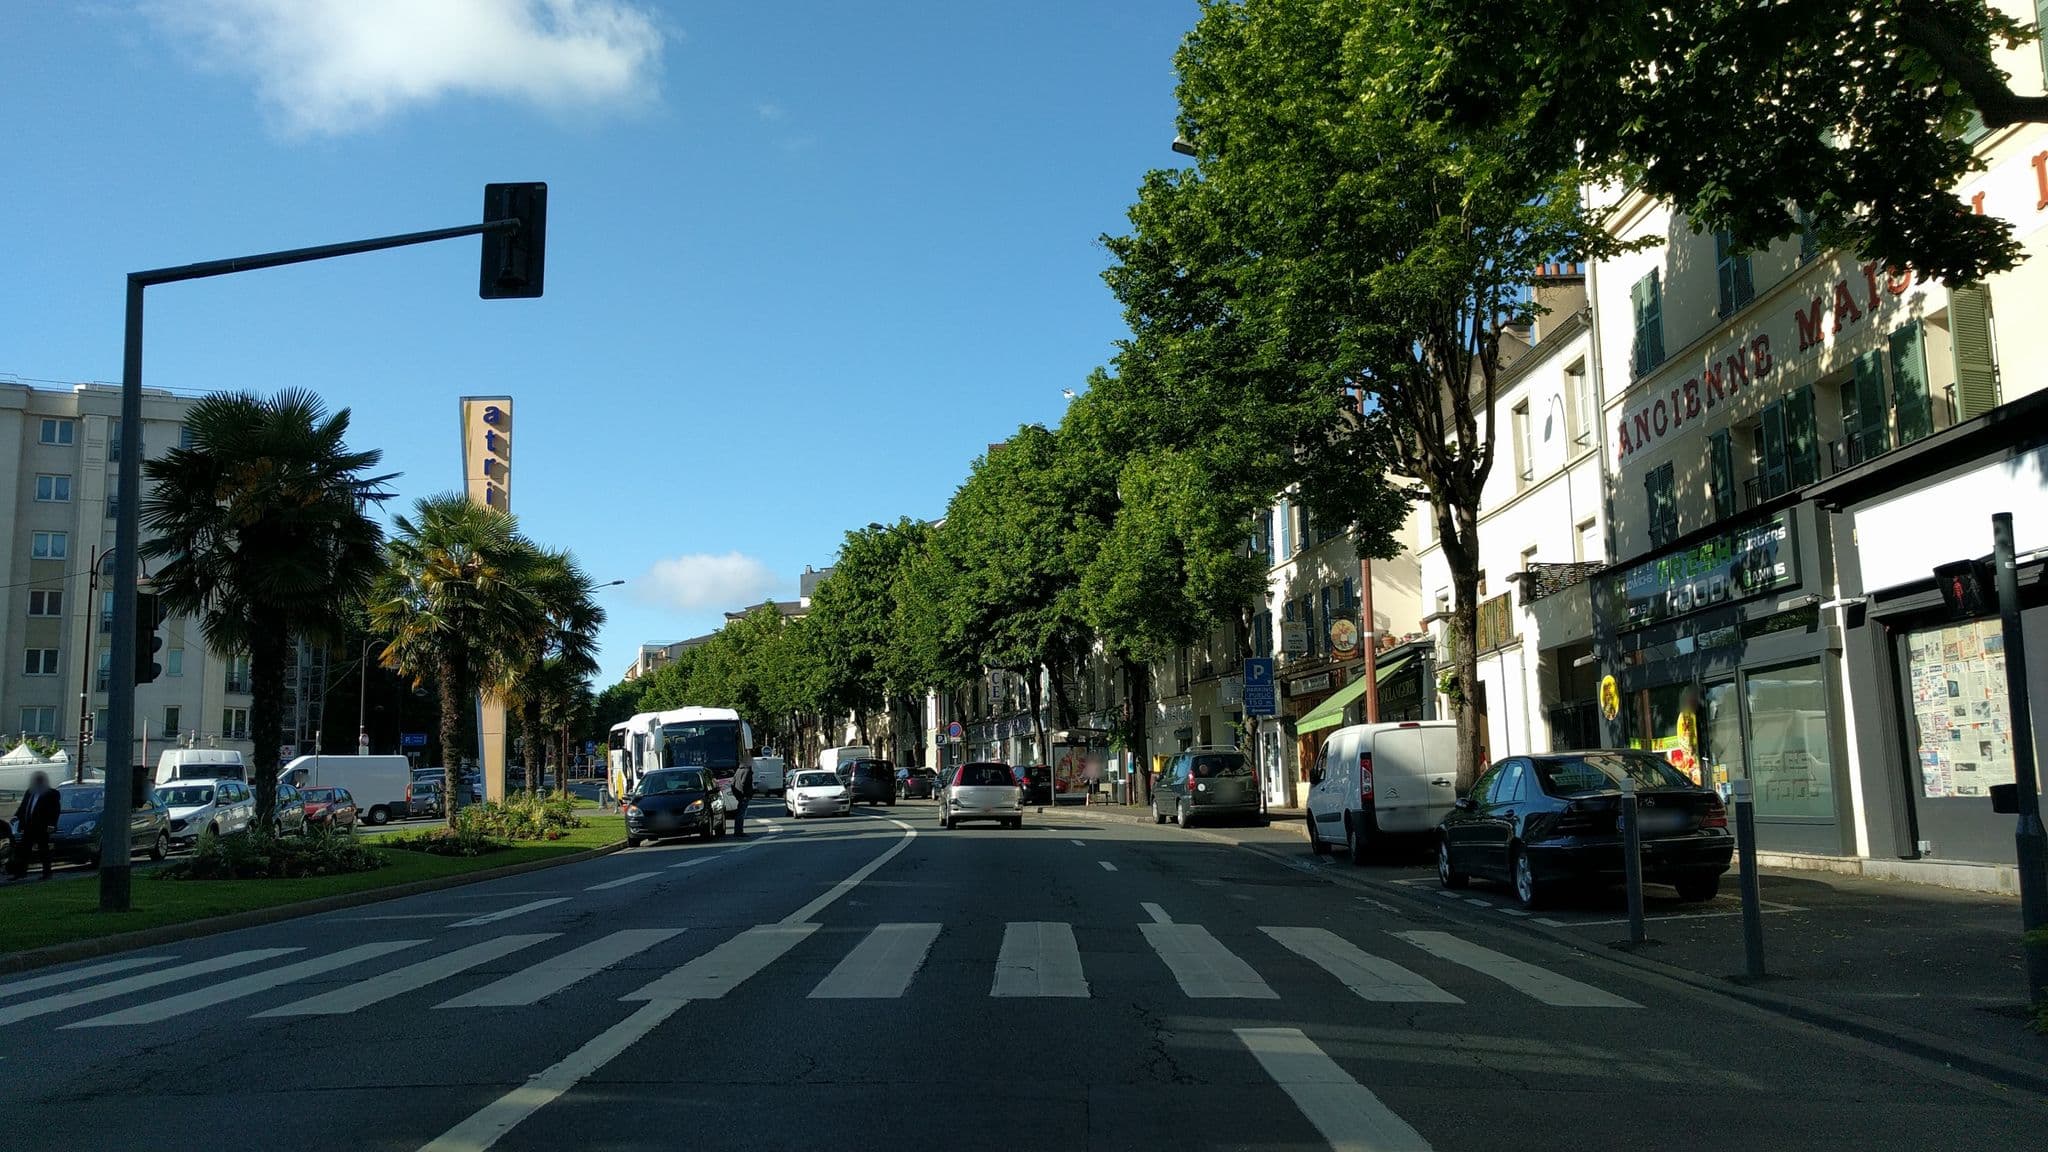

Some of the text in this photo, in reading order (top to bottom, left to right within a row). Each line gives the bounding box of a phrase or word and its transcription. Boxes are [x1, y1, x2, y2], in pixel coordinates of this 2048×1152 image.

[1618, 334, 1772, 460] ANCIENNE
[1657, 536, 1732, 587] FRESH
[1666, 574, 1725, 615] FOOD
[1254, 664, 1265, 679] P
